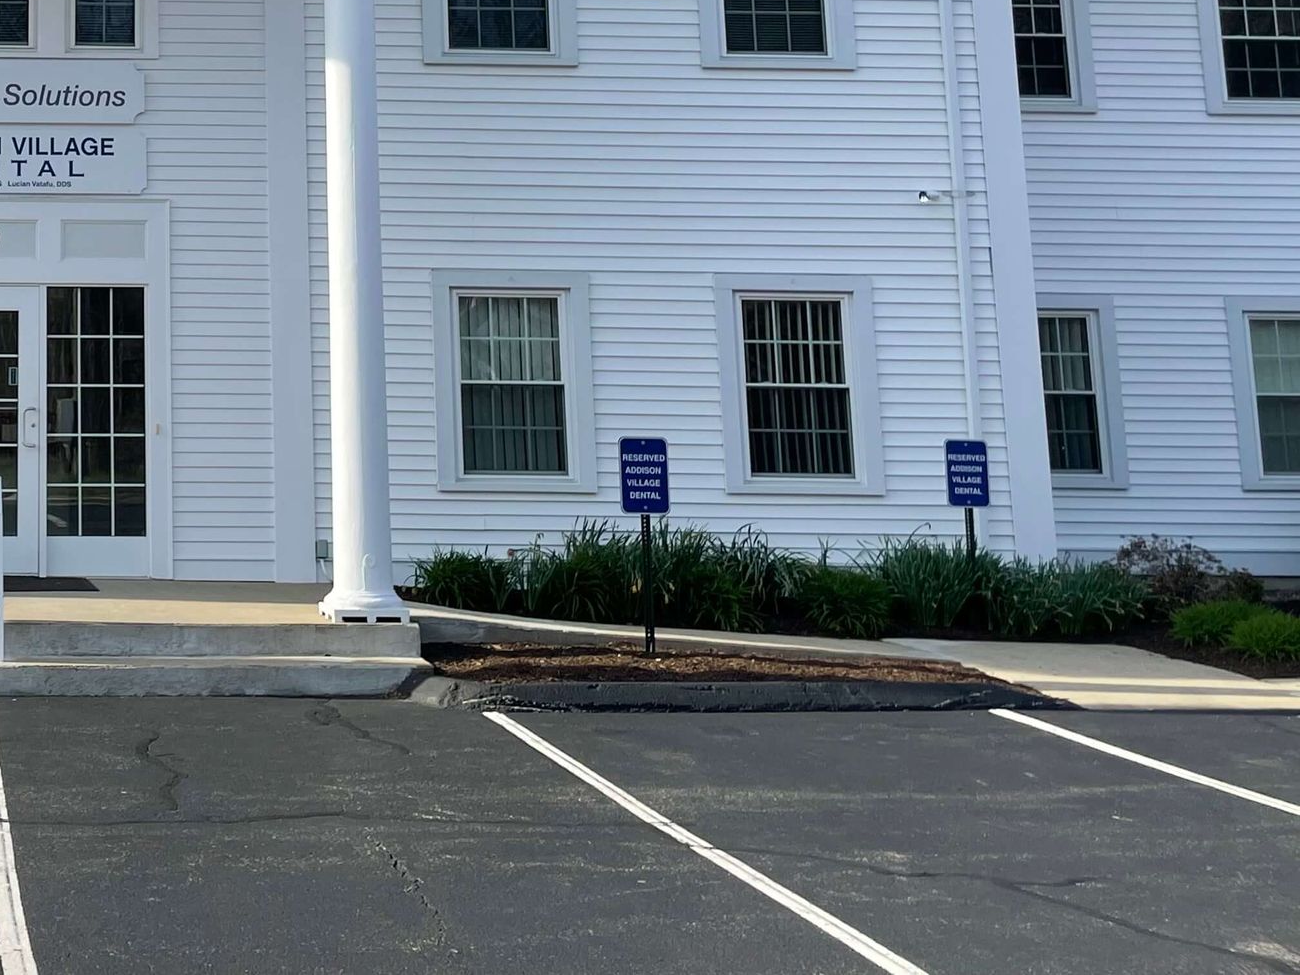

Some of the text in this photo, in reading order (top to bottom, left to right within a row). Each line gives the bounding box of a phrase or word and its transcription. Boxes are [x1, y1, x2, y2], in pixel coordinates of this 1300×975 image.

[3, 83, 126, 107] Solutions
[11, 137, 115, 156] VILLAGE
[56, 180, 72, 188] DDS
[622, 453, 666, 462] RESERVED
[947, 453, 986, 462] RESERVED
[625, 466, 662, 475] ADDISON
[950, 464, 983, 473] ADDISON
[626, 479, 661, 487] VILLAGE
[951, 475, 982, 484] VILLAGE
[629, 491, 661, 500] DENTAL
[954, 487, 983, 495] DENTAL
